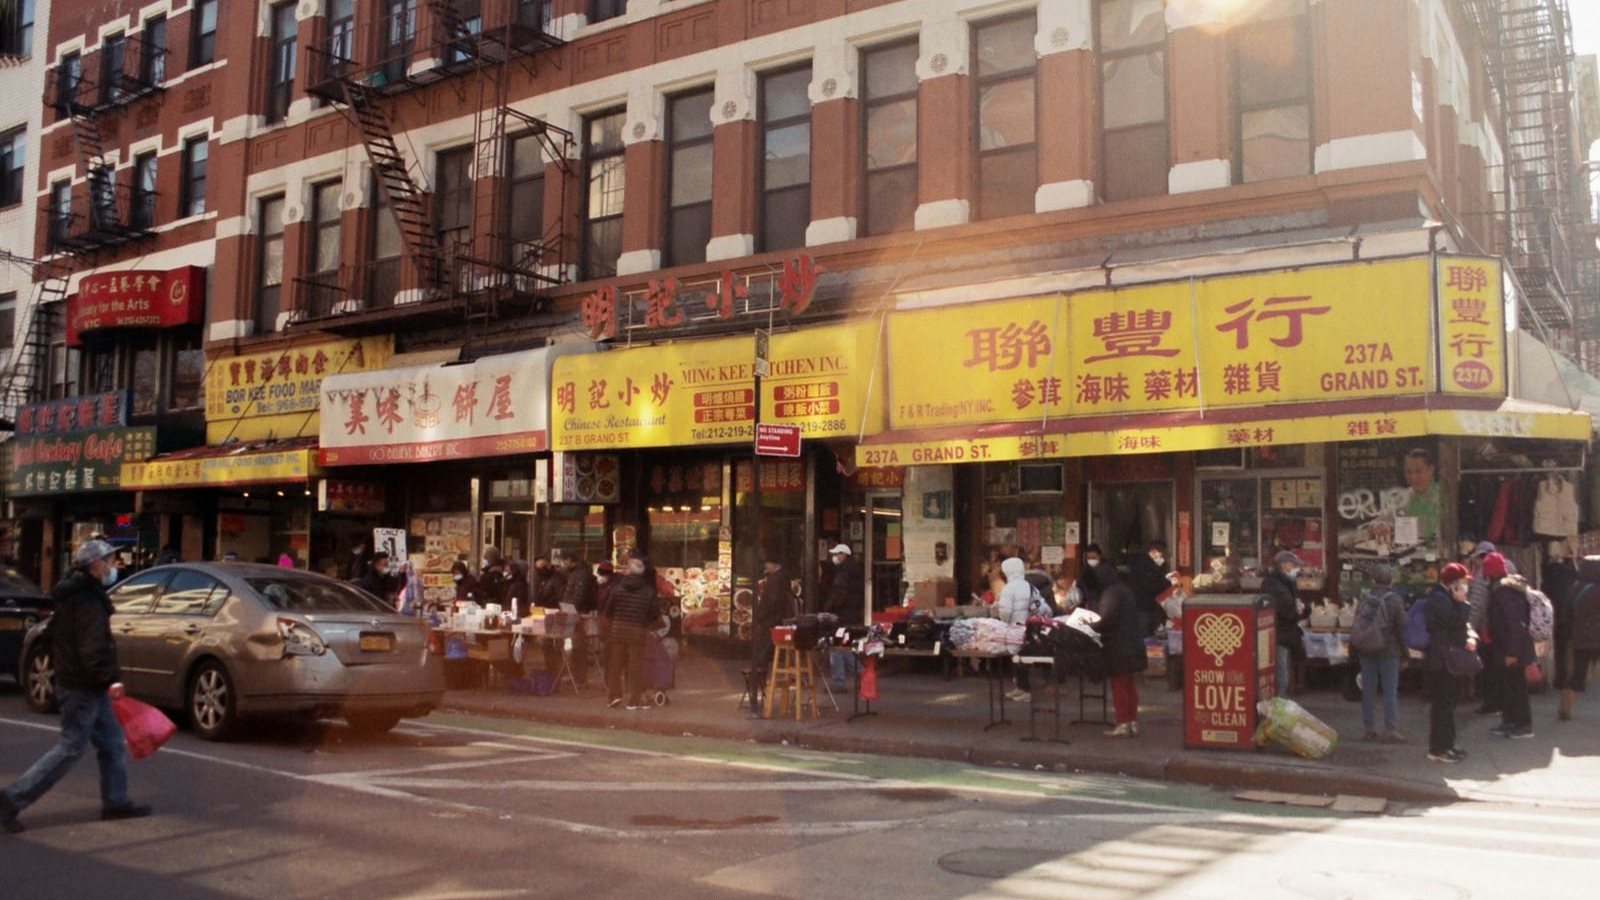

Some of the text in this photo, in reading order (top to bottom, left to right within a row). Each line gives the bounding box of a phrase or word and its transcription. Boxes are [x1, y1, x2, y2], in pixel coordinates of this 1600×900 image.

[111, 299, 124, 311] the
[127, 299, 150, 310] Arts
[581, 254, 823, 340] 明記小炒
[1446, 265, 1493, 360] 聯豐行
[1344, 343, 1393, 364] 237A
[681, 368, 716, 384] MING
[719, 364, 748, 381] KEE
[752, 357, 817, 379] TCHEN
[819, 355, 848, 372] INC.
[1320, 366, 1424, 392] GRAND ST.
[1455, 367, 1491, 385] 237A
[225, 388, 246, 404] BOR
[248, 384, 266, 401] KEE
[269, 381, 296, 399] FOOD
[557, 372, 674, 413] 明記小炒
[1011, 361, 1282, 410] 參茸 海味 藥材 雜貨
[345, 374, 514, 436] 美味餅屋
[564, 414, 666, 431] Chinese Restaurant
[1118, 435, 1161, 450] 海味
[1227, 427, 1275, 444] 藥材
[1347, 418, 1398, 436] 雜貨
[84, 432, 122, 464] Cafe
[584, 432, 616, 445] GRAND
[865, 444, 992, 464] 237A GRAND ST.
[1194, 669, 1225, 684] SHOW
[1194, 685, 1246, 711] LOVE
[1211, 712, 1247, 727] CLEAN
